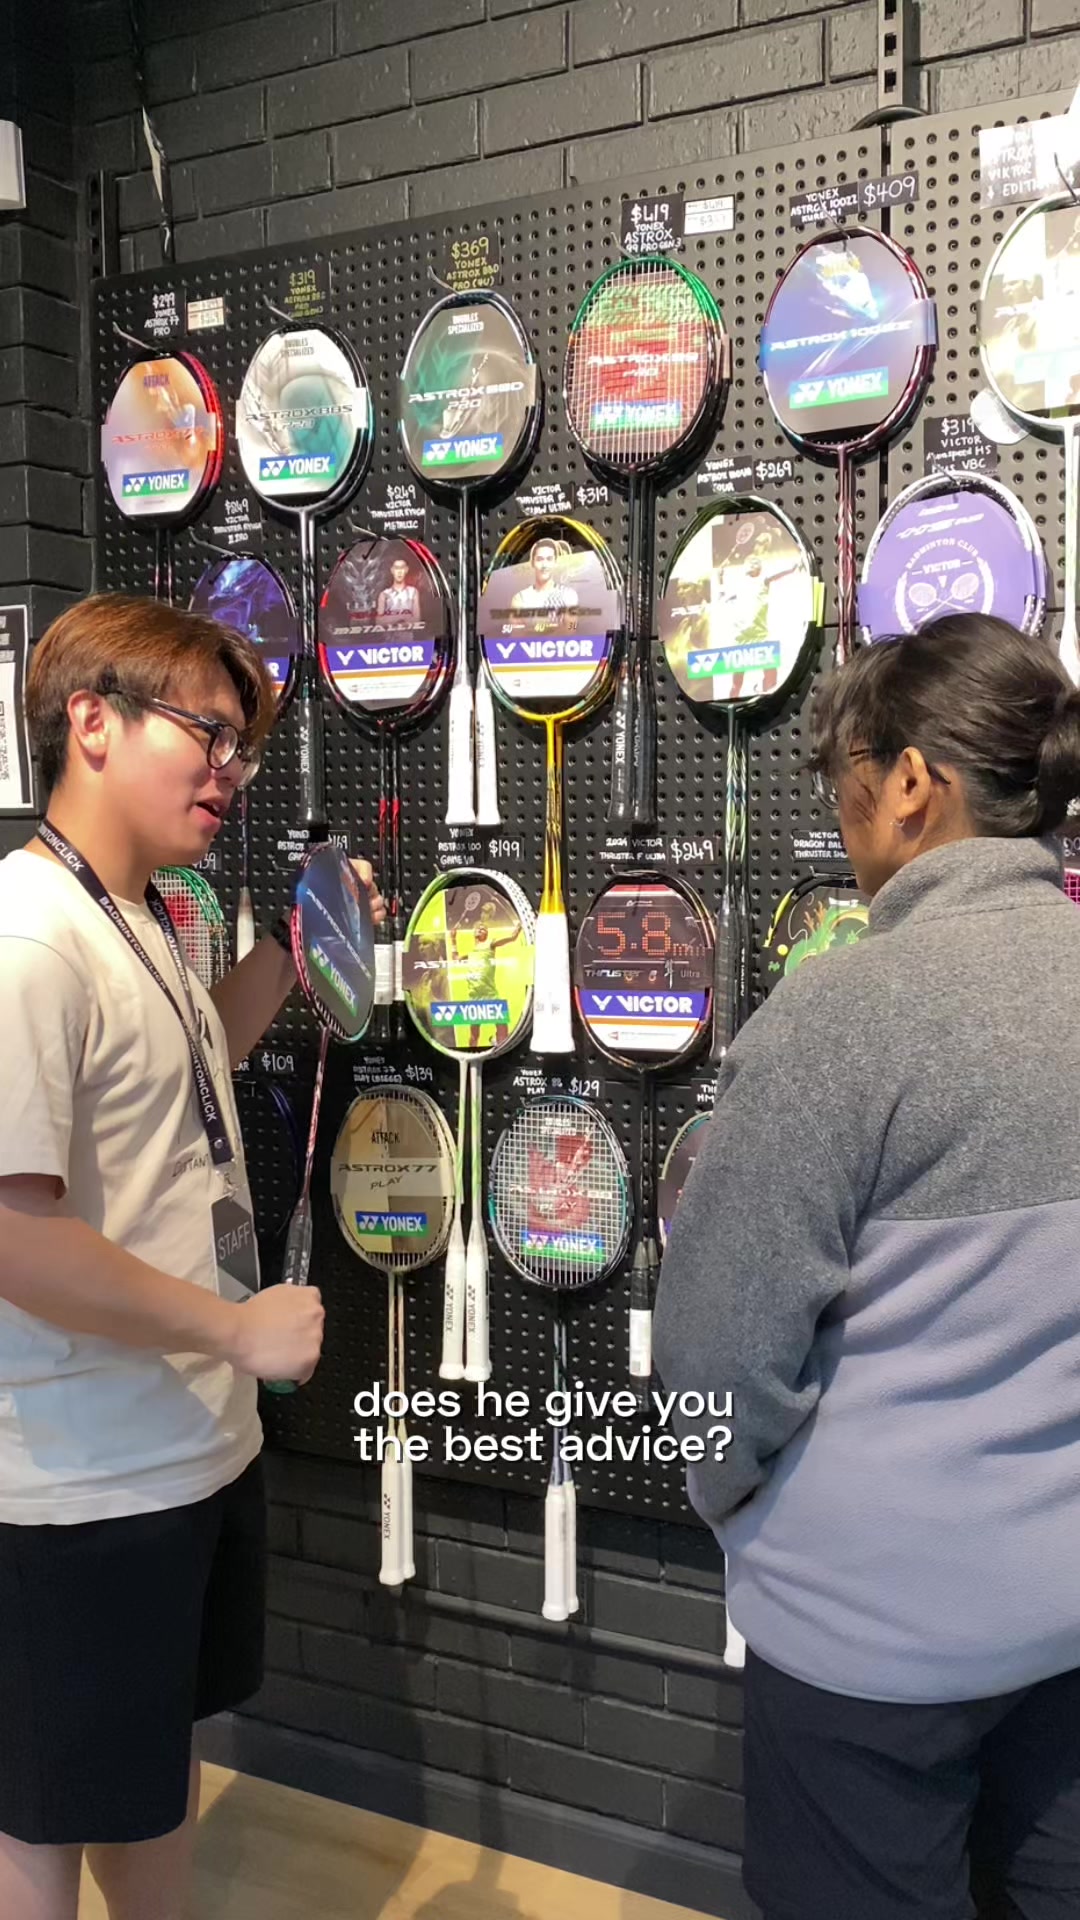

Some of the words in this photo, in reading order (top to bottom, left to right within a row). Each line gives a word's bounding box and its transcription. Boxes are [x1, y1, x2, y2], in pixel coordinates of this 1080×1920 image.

[806, 187, 839, 203] YONEX
[863, 175, 916, 207] $409
[630, 202, 670, 226] $419
[790, 200, 828, 216] ASTROX
[635, 221, 665, 232] YONEX
[624, 228, 673, 245] ASTROX
[451, 236, 490, 260] $369
[625, 243, 639, 253] 99
[640, 242, 658, 252] PRO
[455, 256, 488, 270] YONEX
[288, 268, 316, 287] $319
[446, 269, 482, 281] ASTROX
[290, 284, 317, 296] YONEX
[453, 280, 471, 291] PRO
[152, 291, 176, 309] $299
[155, 308, 177, 319] YONEX
[144, 317, 169, 329] ASTROX
[153, 326, 171, 337] PRO
[827, 371, 883, 400] YONEX
[447, 398, 482, 411] PRO
[625, 403, 677, 423] YONEX
[940, 417, 975, 437] $319
[453, 436, 498, 459] YONEX
[940, 435, 982, 448] VICTOR
[975, 444, 992, 456] HS
[288, 456, 331, 475] YONEX
[705, 458, 735, 472] YONEX
[755, 460, 793, 481] $269
[962, 457, 987, 471] VBC
[148, 472, 185, 491] YONEX
[531, 484, 562, 494] VICTOR
[386, 484, 417, 502] $249
[576, 486, 609, 506] $319
[905, 538, 956, 570] BADMINTON
[957, 538, 979, 558] CLUB
[922, 559, 961, 575] VICTOR
[333, 620, 426, 636] METALLIC
[357, 645, 425, 666] VICTOR
[519, 639, 594, 659] VICTOR
[721, 645, 776, 670] YONEX
[614, 731, 626, 765] YONEX
[300, 742, 311, 774] YONEX
[631, 838, 663, 847] VICTOR
[793, 839, 826, 849] DRAGON
[827, 840, 843, 849] BAL
[808, 831, 840, 839] VICTOR
[488, 838, 520, 858] $199
[670, 838, 715, 865] $249
[794, 850, 832, 859] THRUSTER
[440, 855, 462, 866] GAME
[328, 962, 357, 1009] YONEX
[459, 1003, 505, 1021] YONEX
[616, 996, 693, 1014] VICTOR
[261, 1051, 295, 1072] $109
[404, 1064, 434, 1082] $139
[513, 1076, 548, 1087] ASTROX
[526, 1087, 546, 1095] PLAY
[568, 1076, 600, 1098] $129
[371, 1130, 400, 1145] ATTACK
[369, 1175, 403, 1190] PLAY
[380, 1215, 424, 1233] YONEX
[217, 1221, 251, 1261] STAFF
[551, 1236, 598, 1255] YONEX
[445, 1302, 455, 1332] YONEX
[467, 1303, 477, 1333] YONEX
[384, 1511, 392, 1540] YONEX
